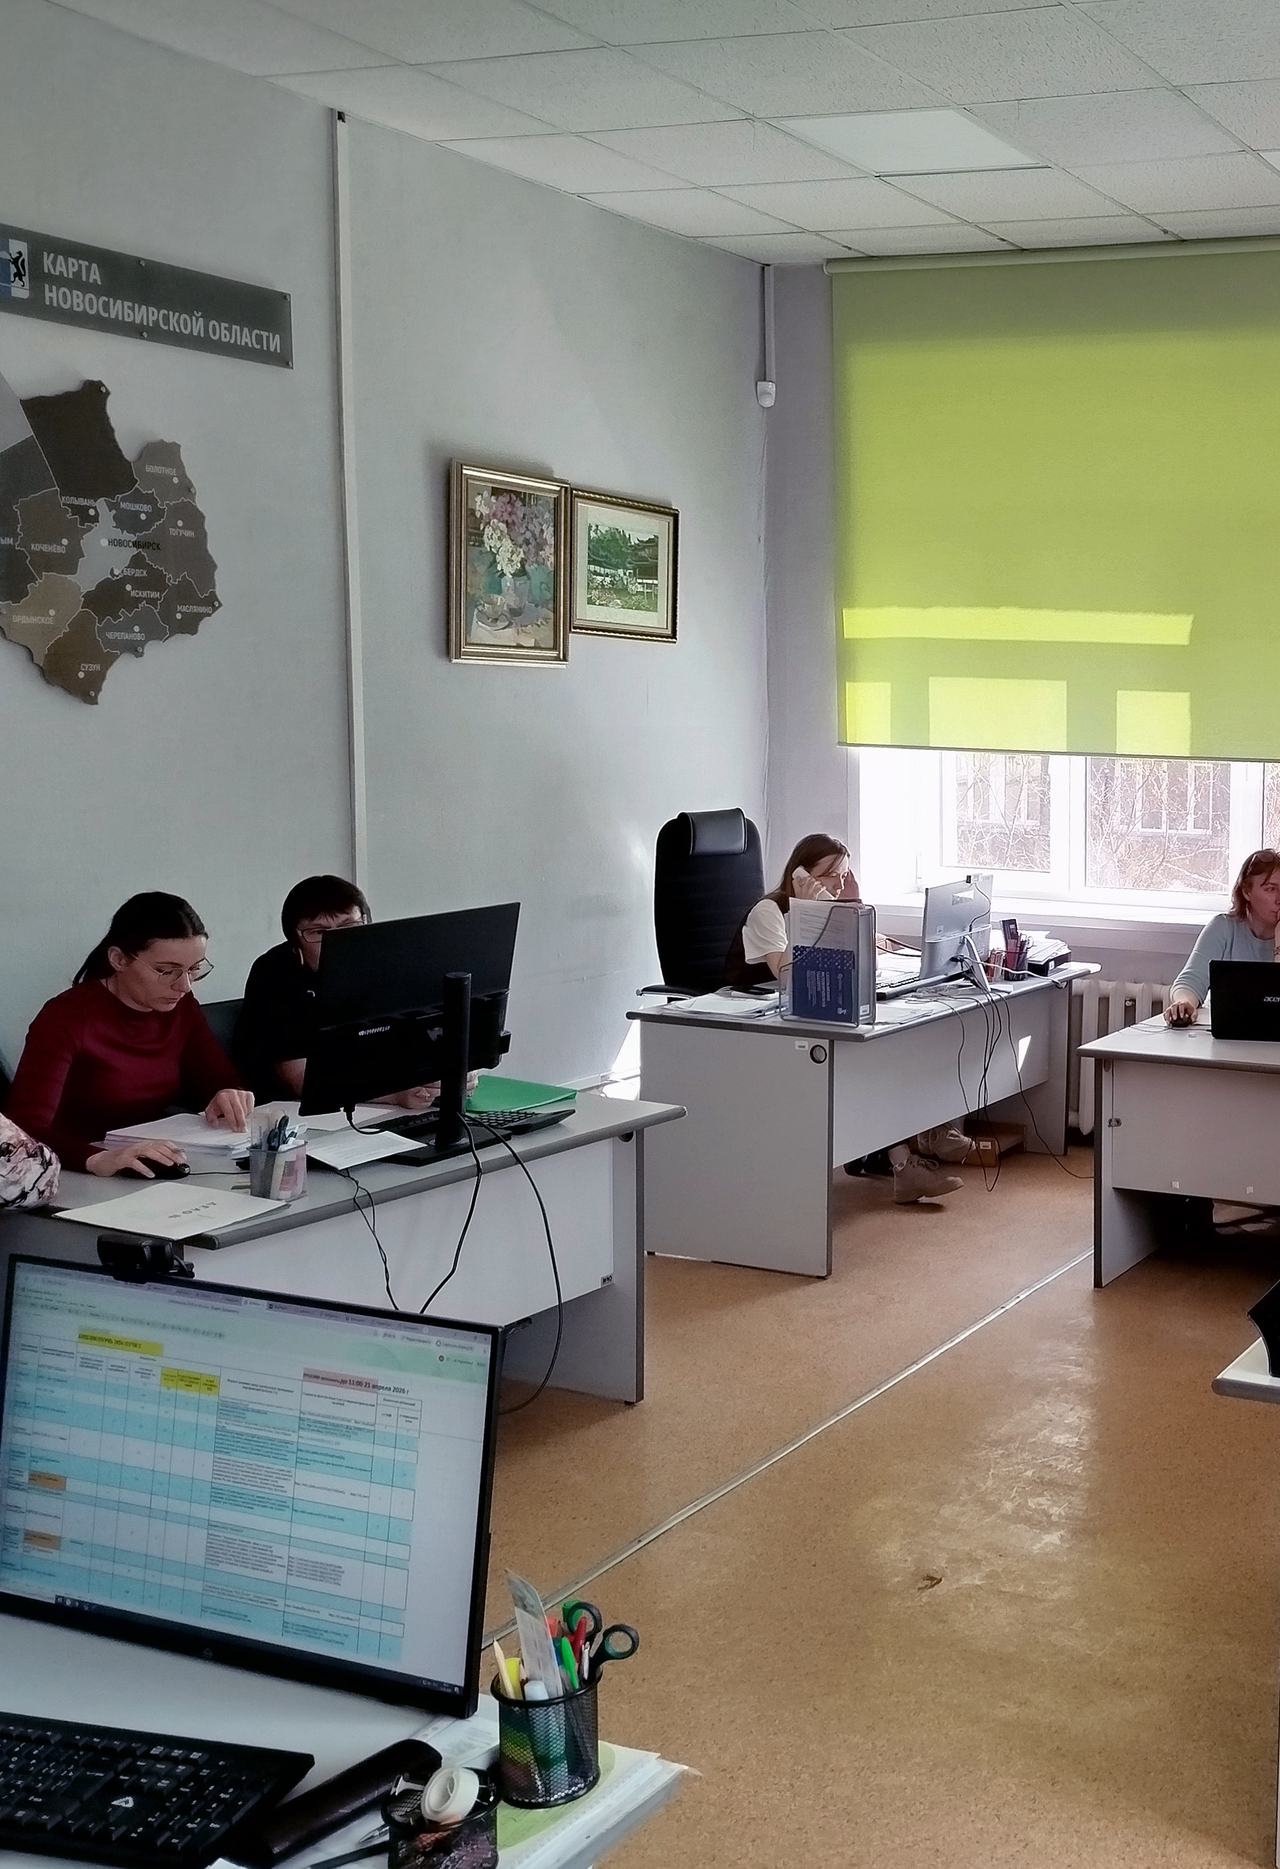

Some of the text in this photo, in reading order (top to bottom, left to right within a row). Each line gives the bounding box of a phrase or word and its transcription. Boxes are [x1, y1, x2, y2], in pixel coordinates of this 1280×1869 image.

[43, 251, 102, 285] КАРТА
[44, 283, 281, 353] НОВОСИБИРСКОЙ ОБЛАСТИ
[120, 502, 153, 513] МОШКОВО
[169, 528, 195, 538] ТОГУЧИН
[107, 538, 162, 551] НОВОСИБИРСК
[123, 568, 148, 578] БЕРДСК
[130, 589, 160, 599] ИСКИТИМ
[177, 604, 213, 614] МАСЛЯНИНО
[105, 631, 146, 641] ЧЕРЕПАНОВО
[80, 663, 101, 672] СУЗУН
[371, 1384, 392, 1392] апреля
